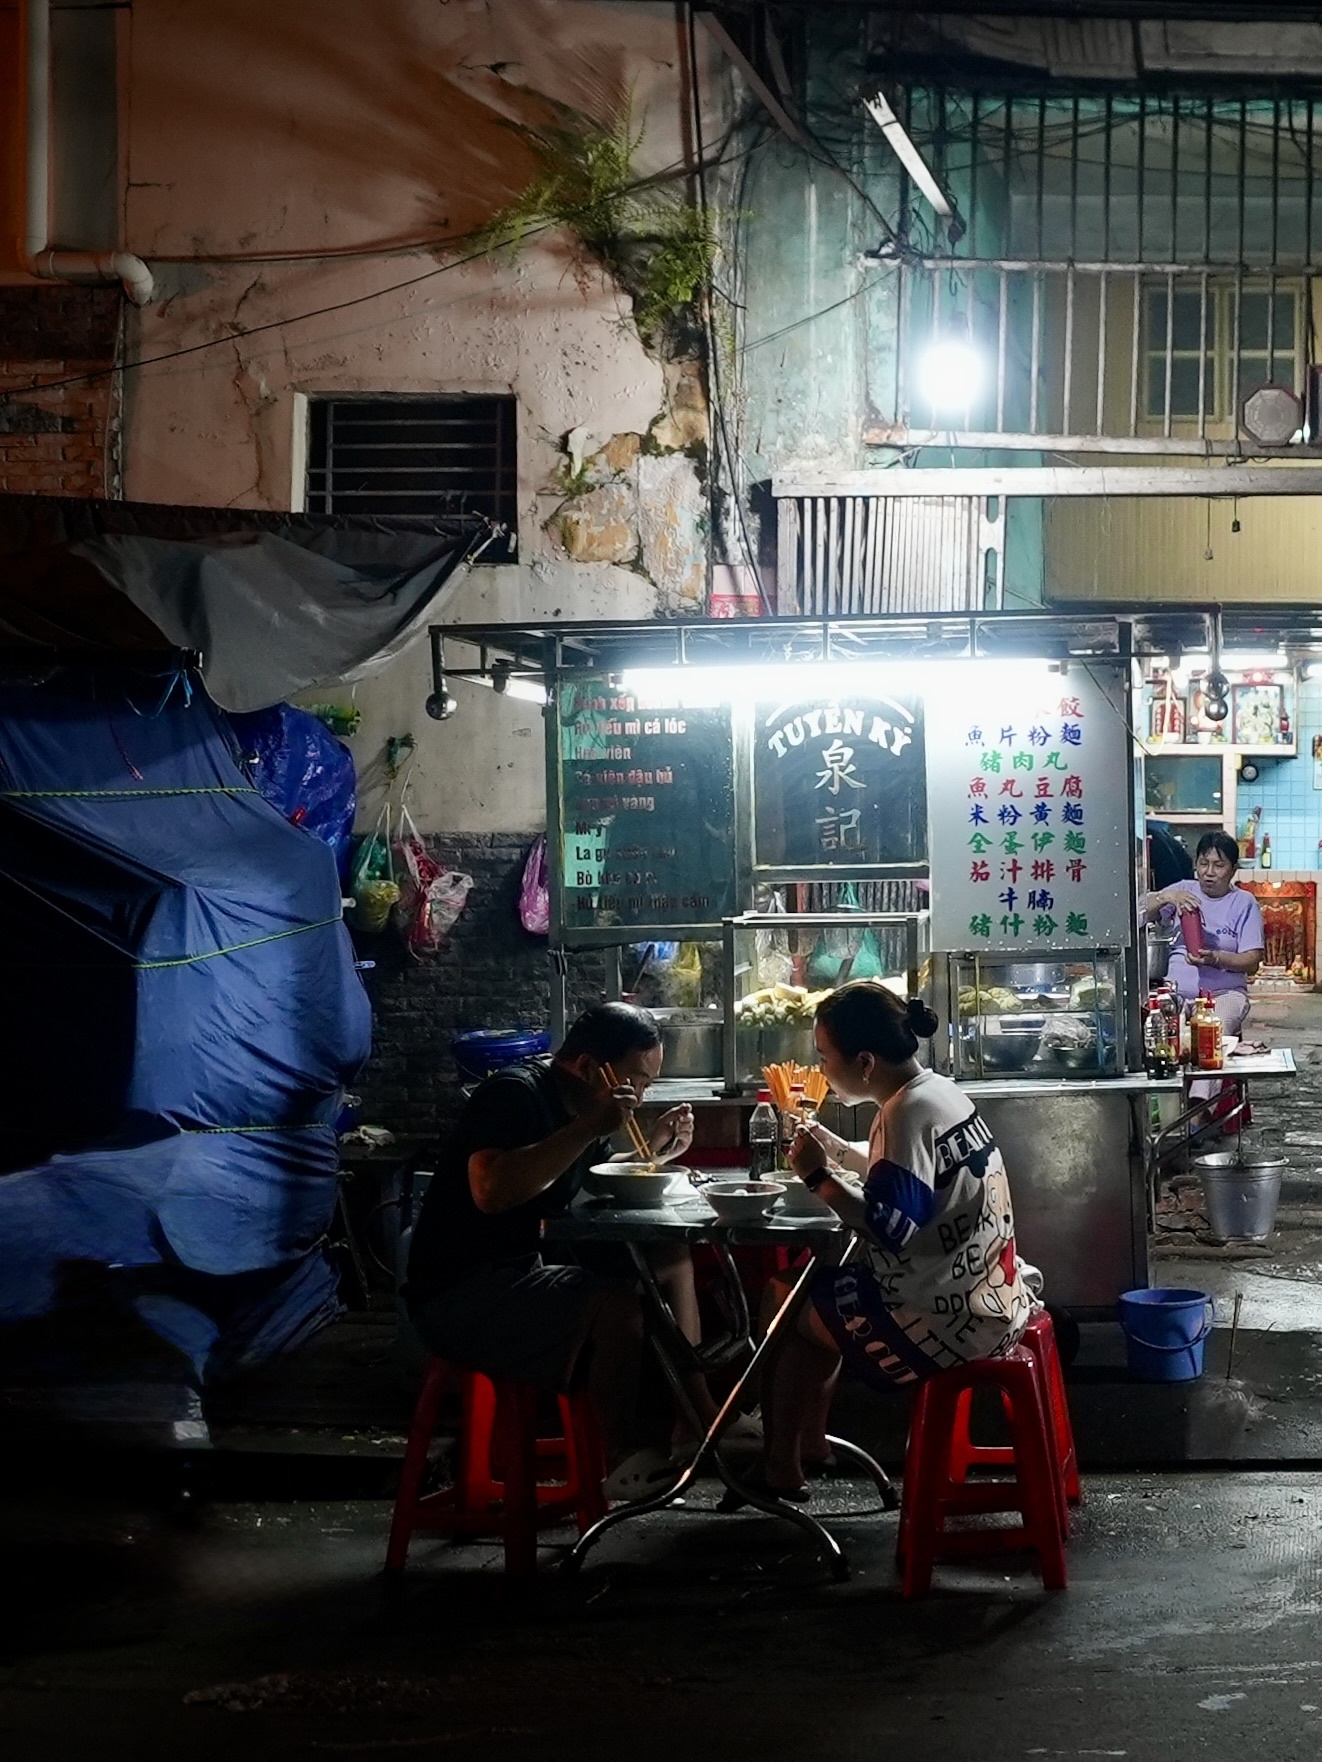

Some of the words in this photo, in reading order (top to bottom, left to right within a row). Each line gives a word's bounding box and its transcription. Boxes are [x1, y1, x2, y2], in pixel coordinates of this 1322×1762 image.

[625, 718, 641, 735] mì
[645, 717, 661, 735] cá
[665, 716, 688, 735] lóc
[868, 717, 912, 757] KÝ
[606, 744, 632, 760] viên
[596, 767, 624, 784] viên
[628, 769, 654, 787] đậu
[656, 765, 674, 784] hủ
[967, 774, 1083, 799] 魚丸豆腐
[813, 738, 868, 852] 泉記
[576, 846, 591, 860] La
[577, 870, 593, 886] Bò
[970, 858, 1087, 884] 茄汁排骨
[998, 886, 1054, 912] 牛腩
